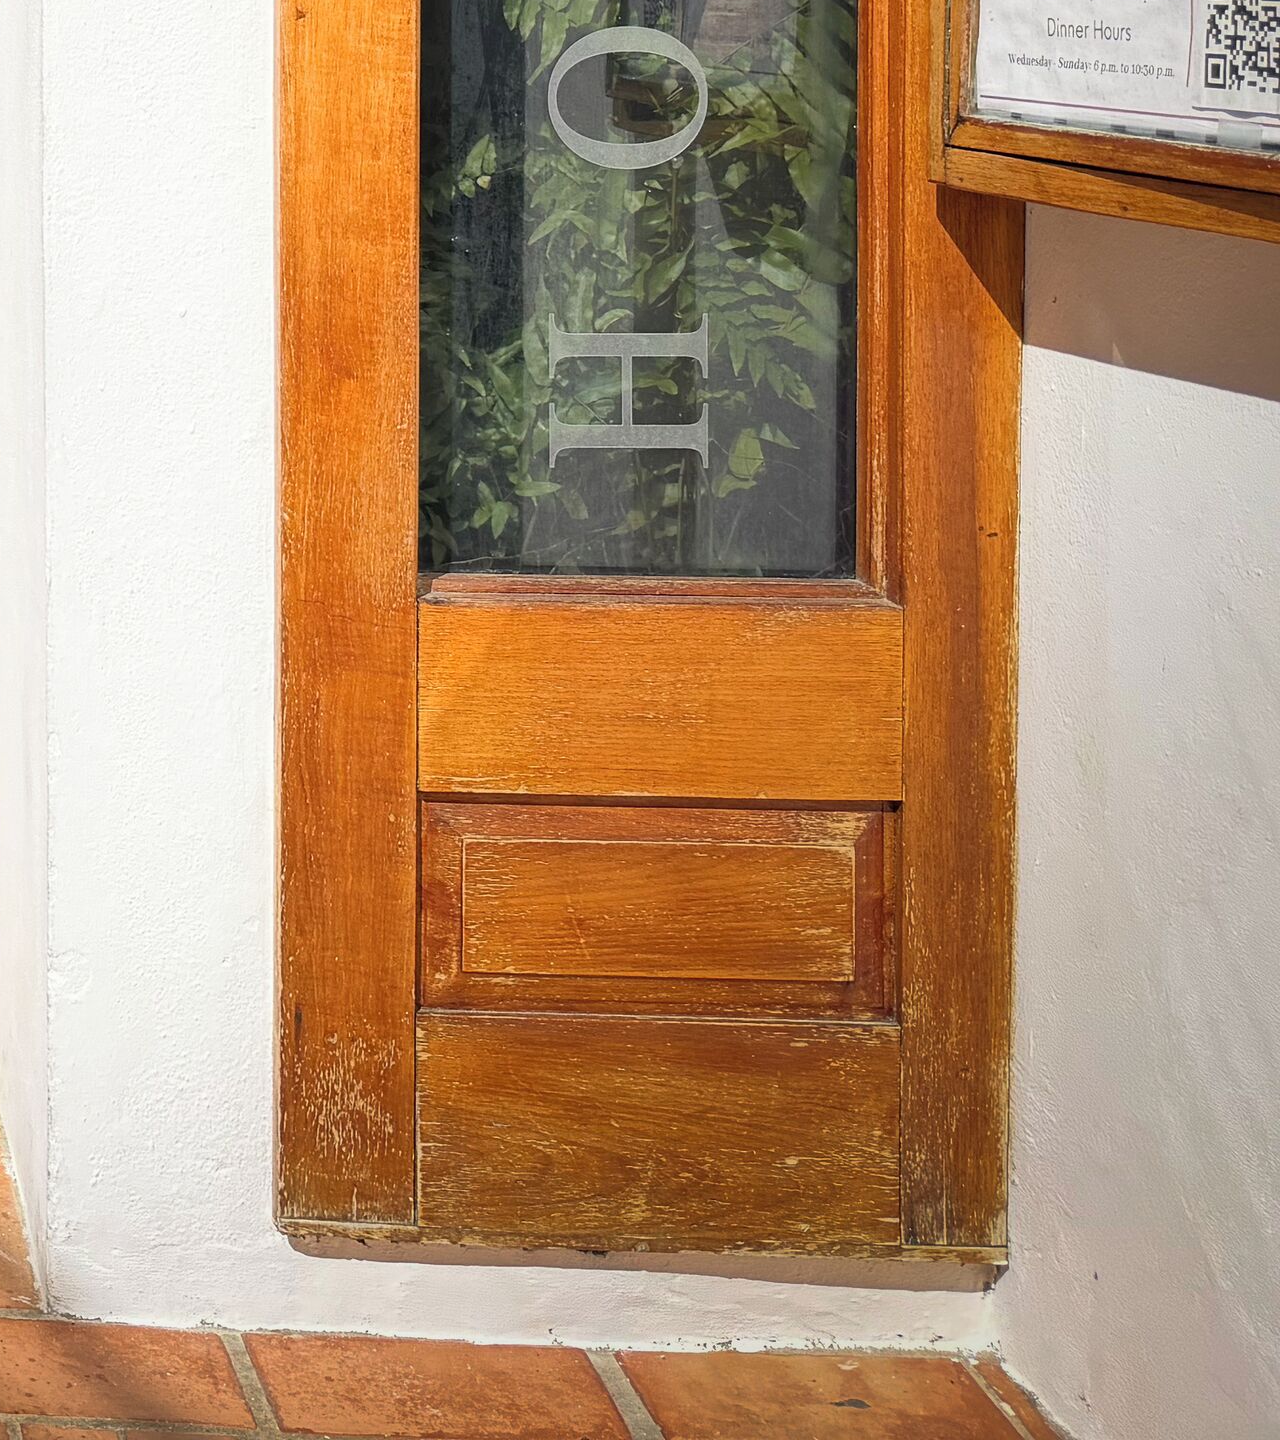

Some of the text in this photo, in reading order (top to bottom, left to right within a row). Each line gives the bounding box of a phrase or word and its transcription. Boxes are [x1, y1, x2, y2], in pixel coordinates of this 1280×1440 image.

[1047, 17, 1131, 41] Dinner Hours
[1008, 53, 1052, 70] Wednesday
[1057, 56, 1091, 73] Sunday:
[1093, 59, 1099, 71] 6
[1100, 63, 1118, 74] p.m.
[1130, 63, 1154, 77] 10:30
[1156, 65, 1175, 79] p.m.
